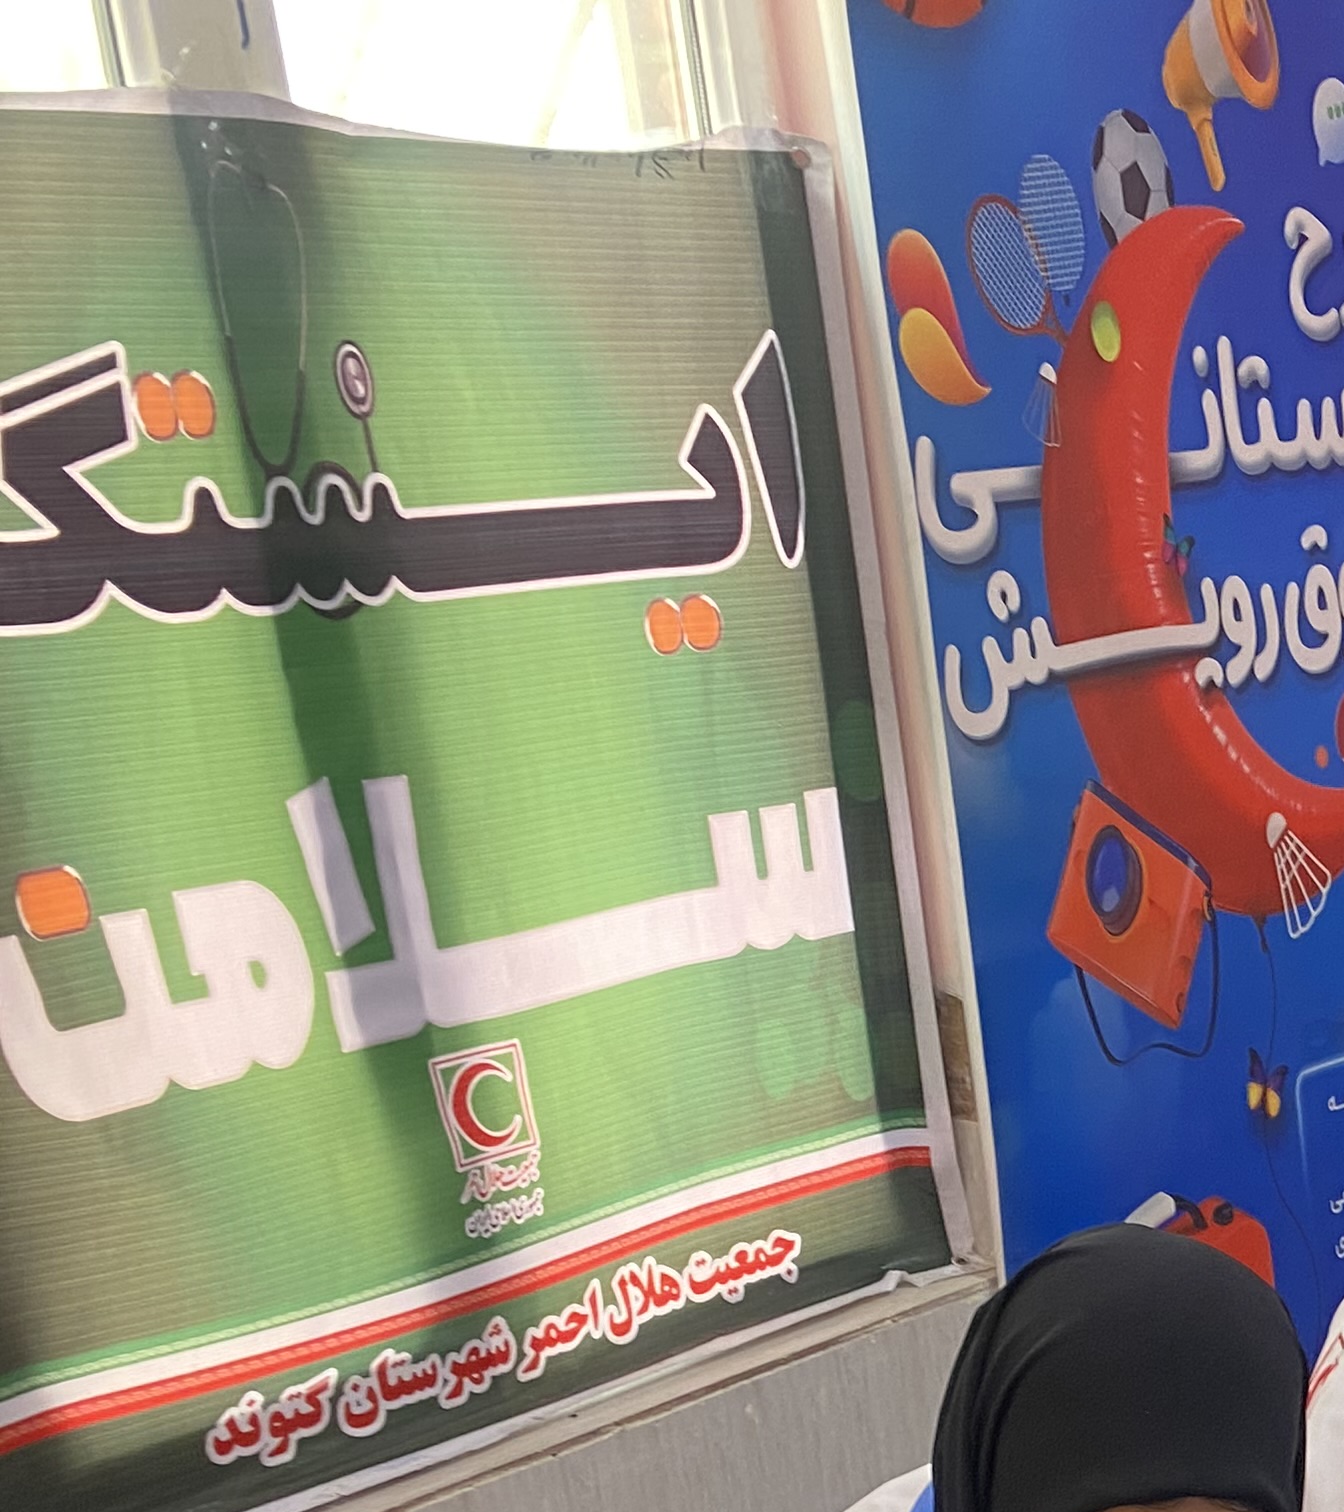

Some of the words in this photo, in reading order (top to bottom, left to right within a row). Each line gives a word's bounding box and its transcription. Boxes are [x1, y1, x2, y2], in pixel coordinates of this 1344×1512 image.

[943, 568, 1283, 741] رویش
[608, 1260, 682, 1339] هلال
[688, 1235, 797, 1299] جمعیت
[343, 1321, 512, 1431] شهرستان
[520, 1285, 601, 1376] احمر
